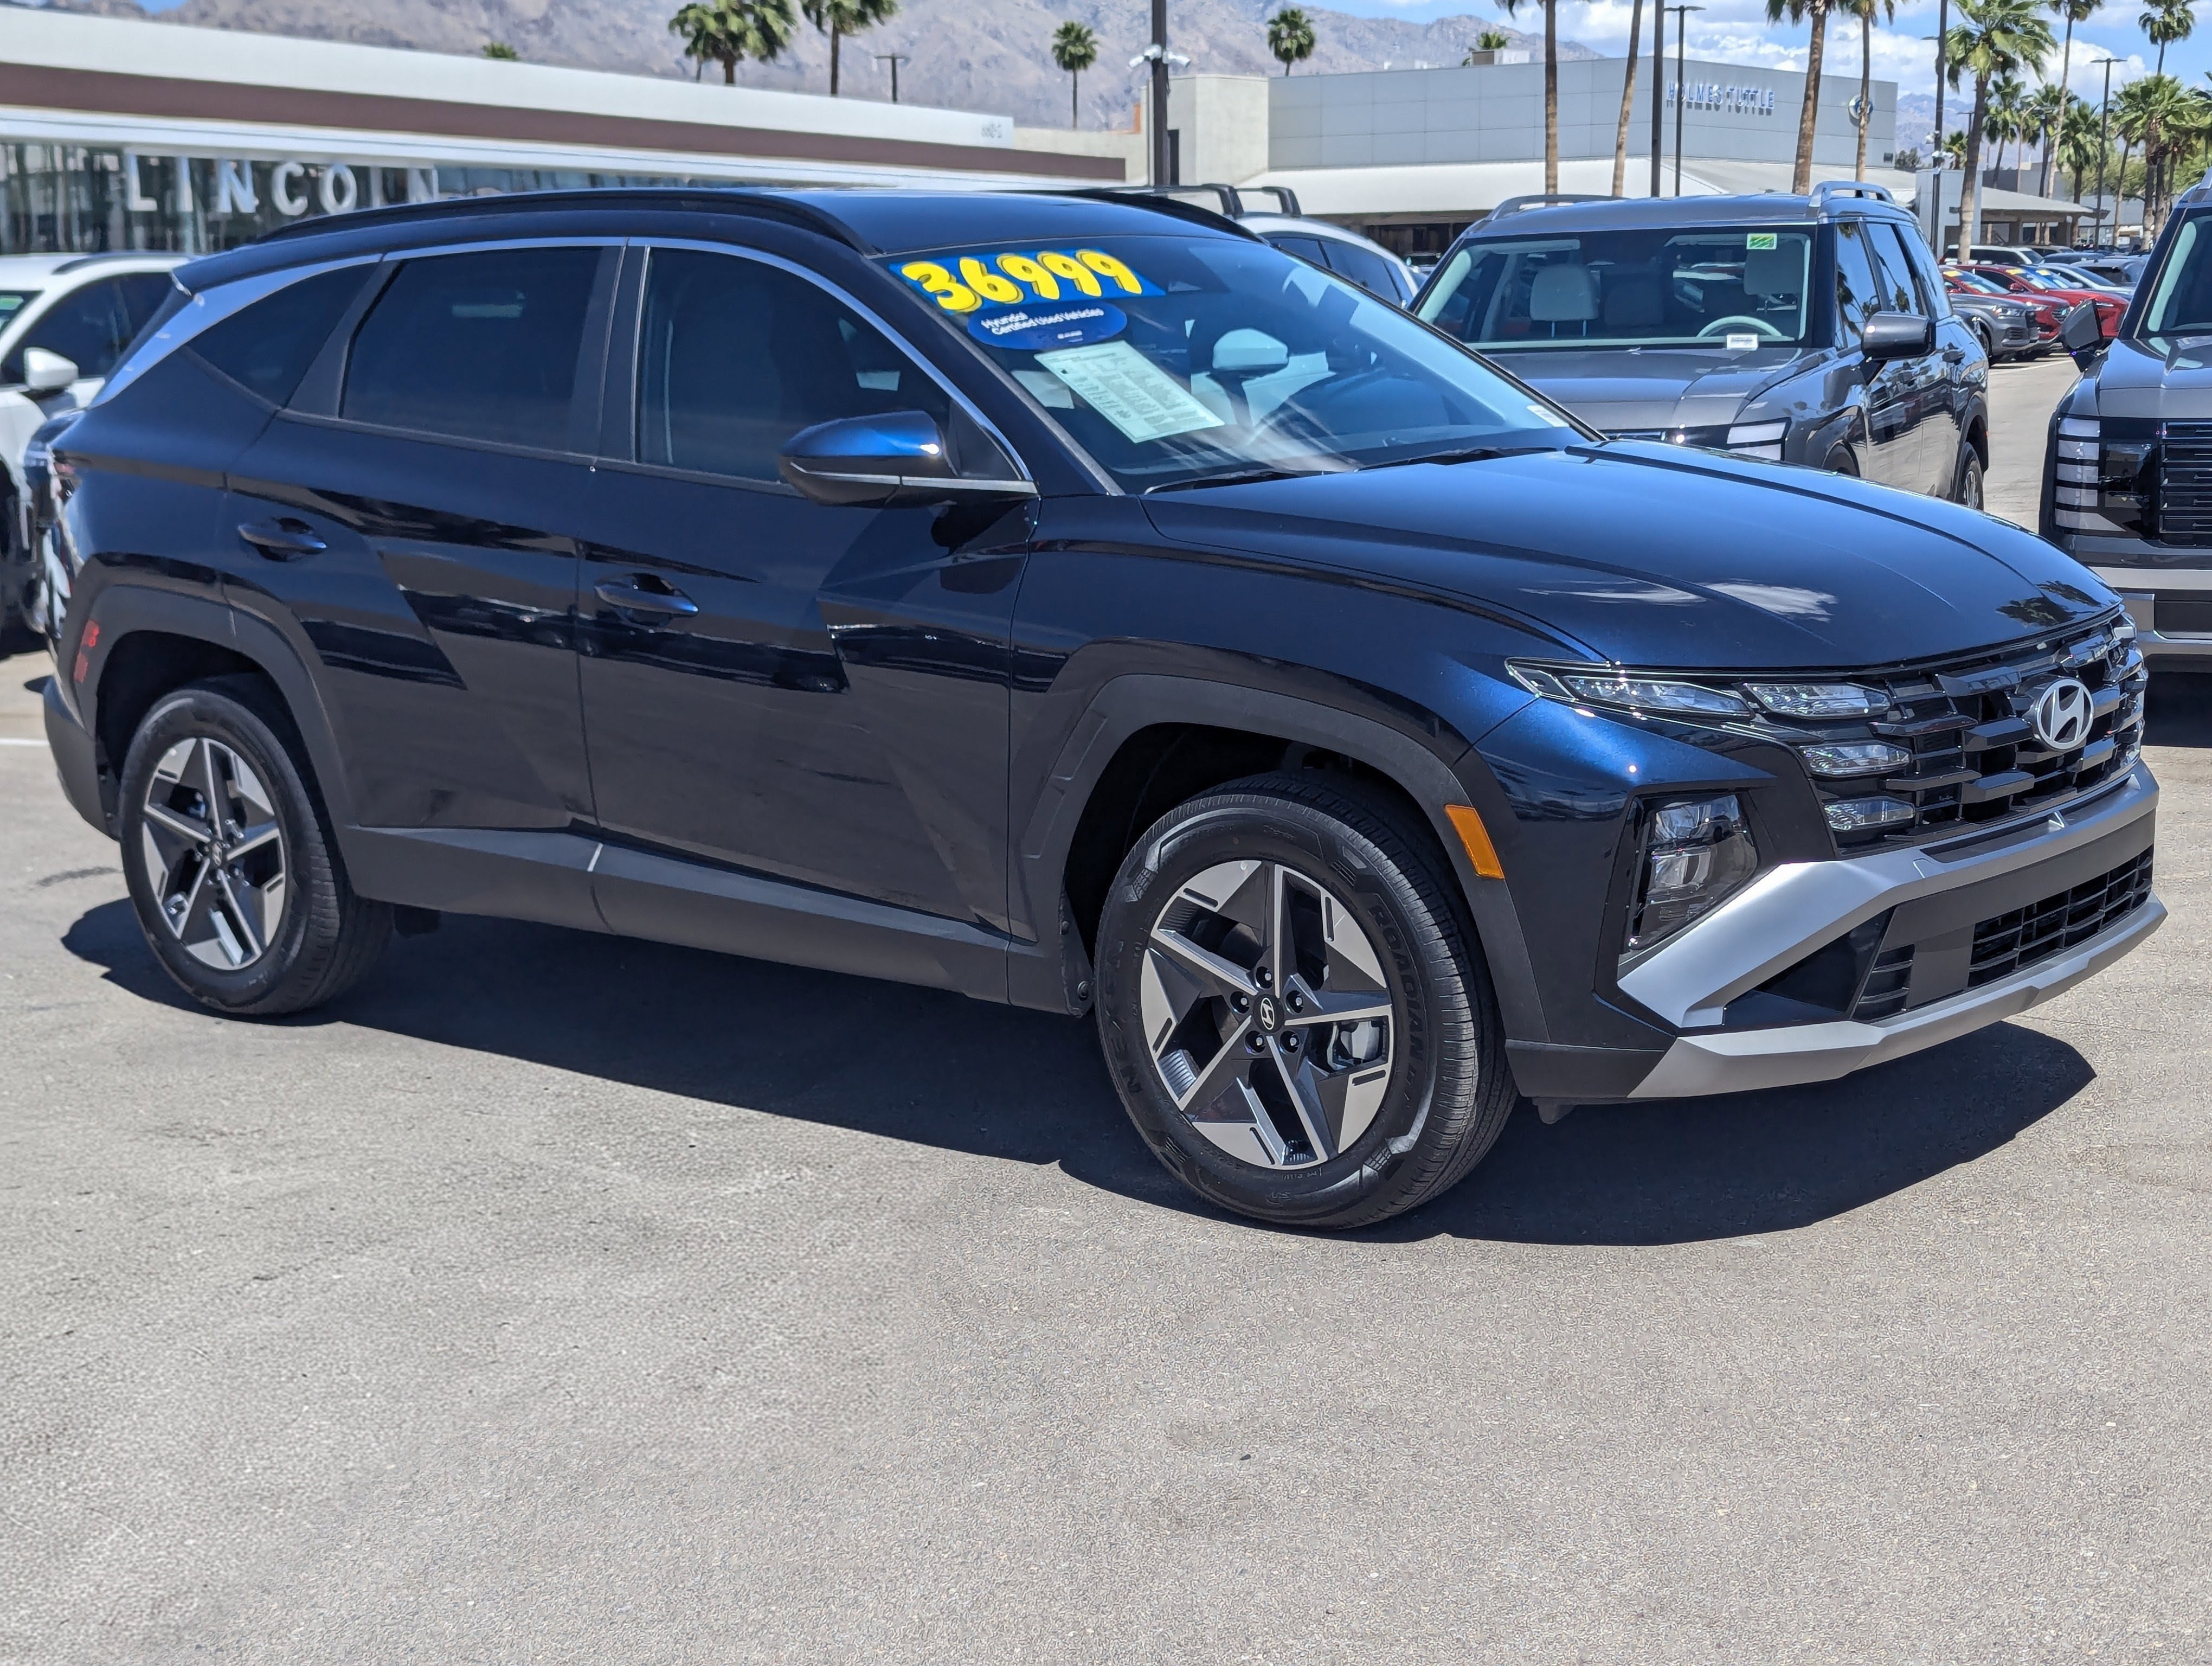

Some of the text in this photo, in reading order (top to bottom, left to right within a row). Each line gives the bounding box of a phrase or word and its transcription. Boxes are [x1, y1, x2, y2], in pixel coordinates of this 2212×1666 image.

[1727, 87, 1774, 109] TUTTLE
[902, 249, 1142, 312] 36999
[981, 311, 1028, 329] Hyundai
[991, 308, 1105, 335] Certified Used Vehicles
